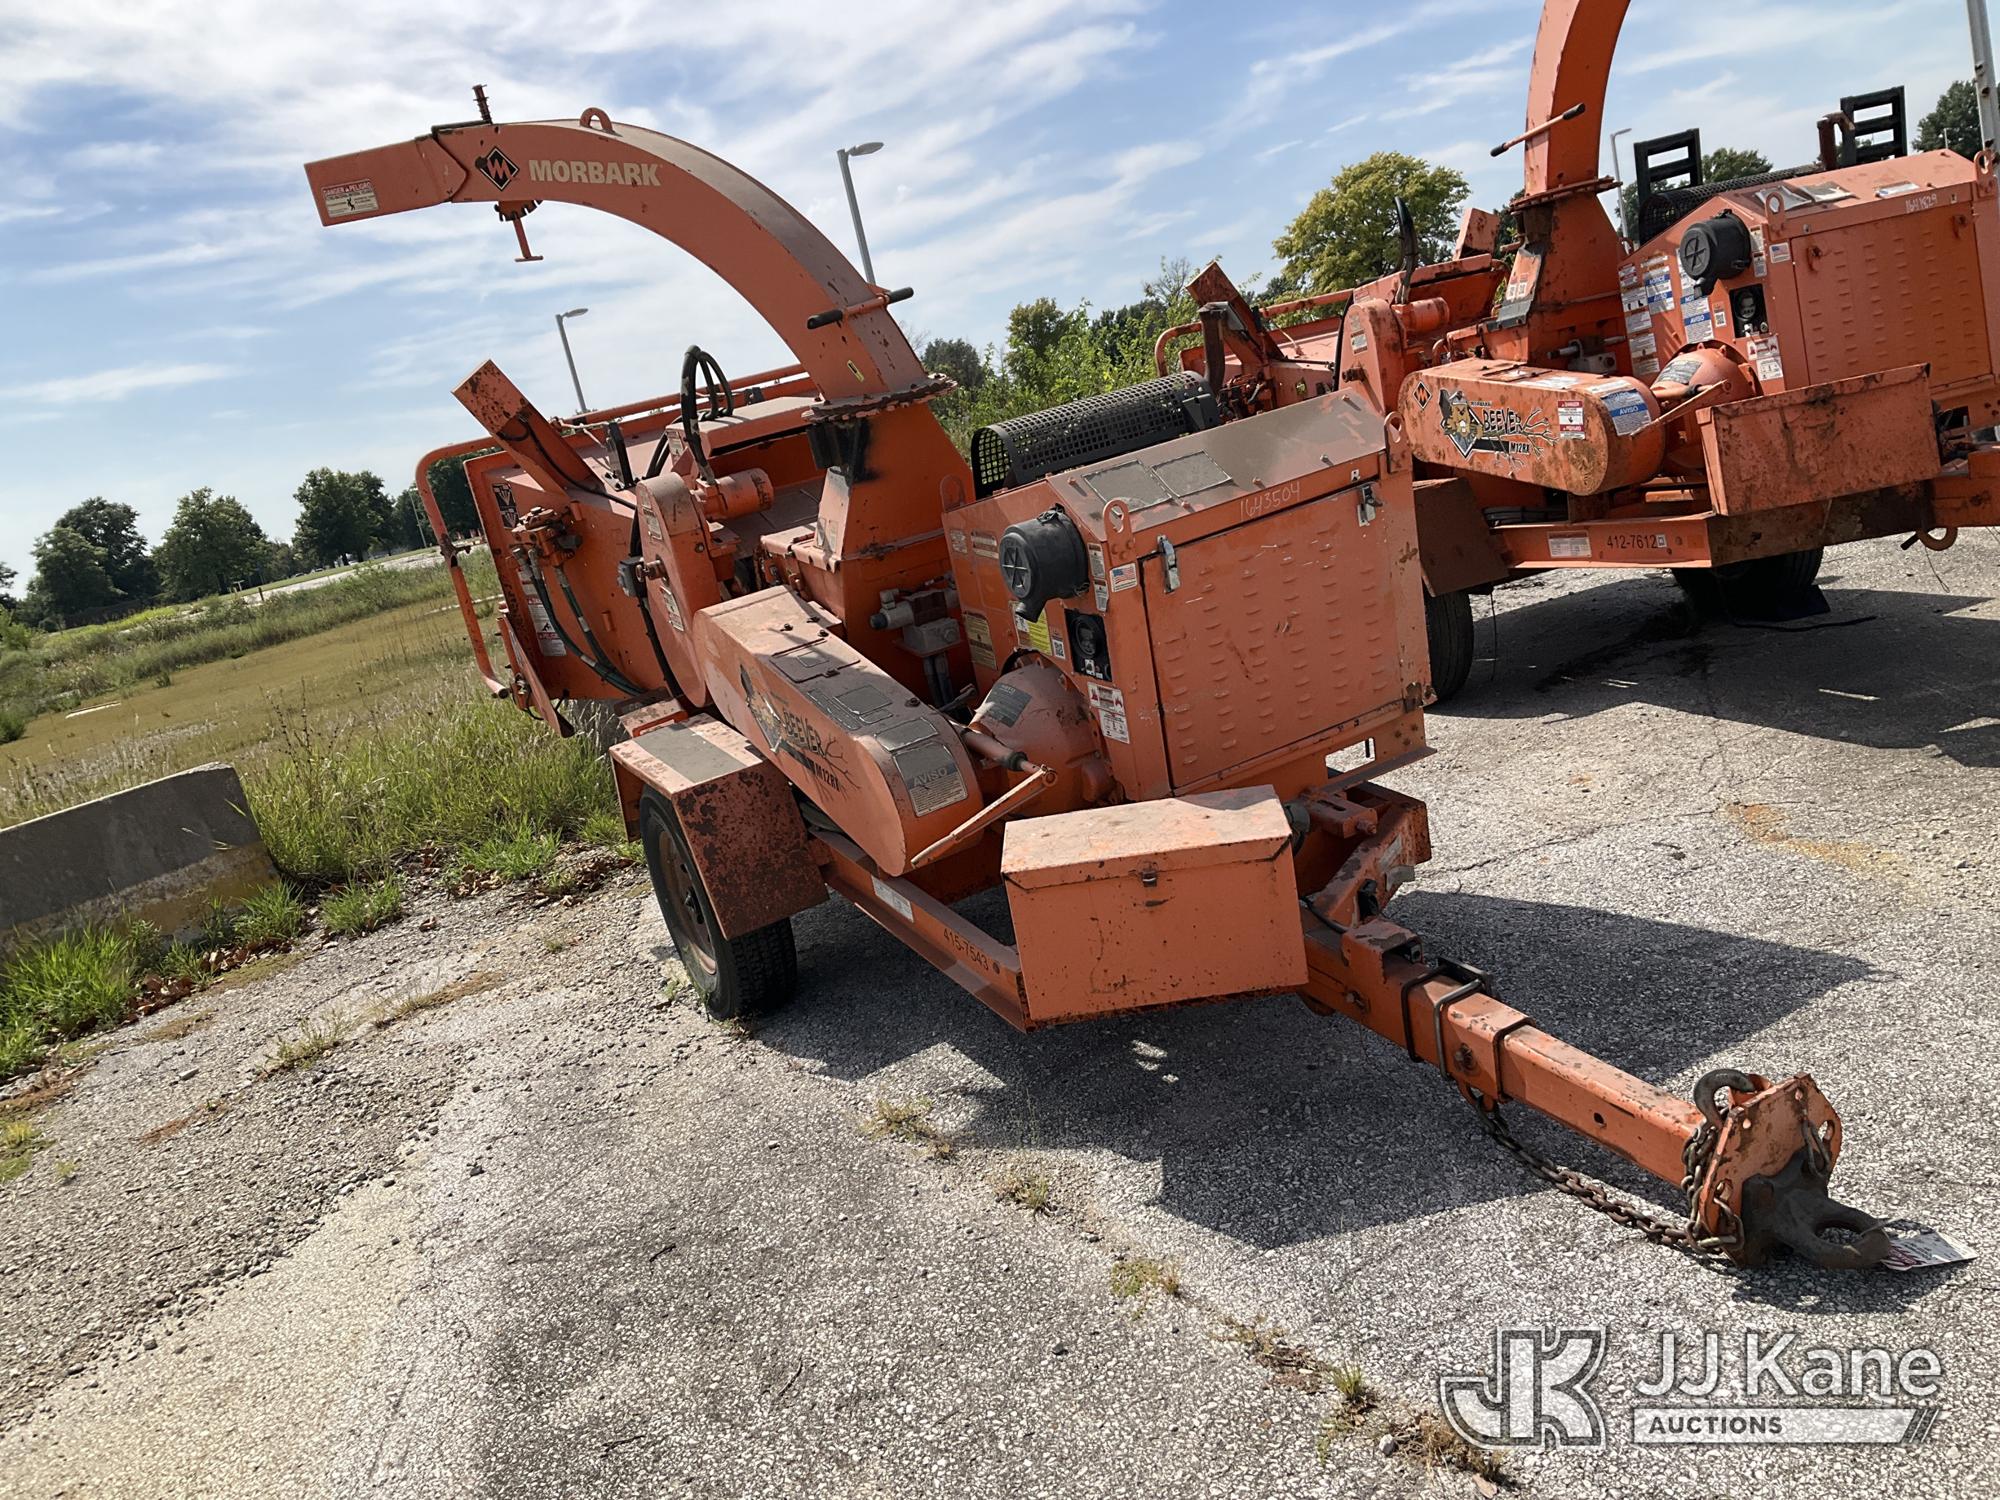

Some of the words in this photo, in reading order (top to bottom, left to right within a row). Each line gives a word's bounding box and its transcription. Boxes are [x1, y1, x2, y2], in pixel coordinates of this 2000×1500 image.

[529, 159, 662, 186] MORBARK
[1482, 408, 1523, 434] BEEVER
[1619, 405, 1640, 416] AVISO
[1240, 480, 1300, 521] 1643504
[1607, 534, 1658, 549] 412-7612
[912, 767, 948, 787] AVISO
[943, 928, 989, 971] 415-7543
